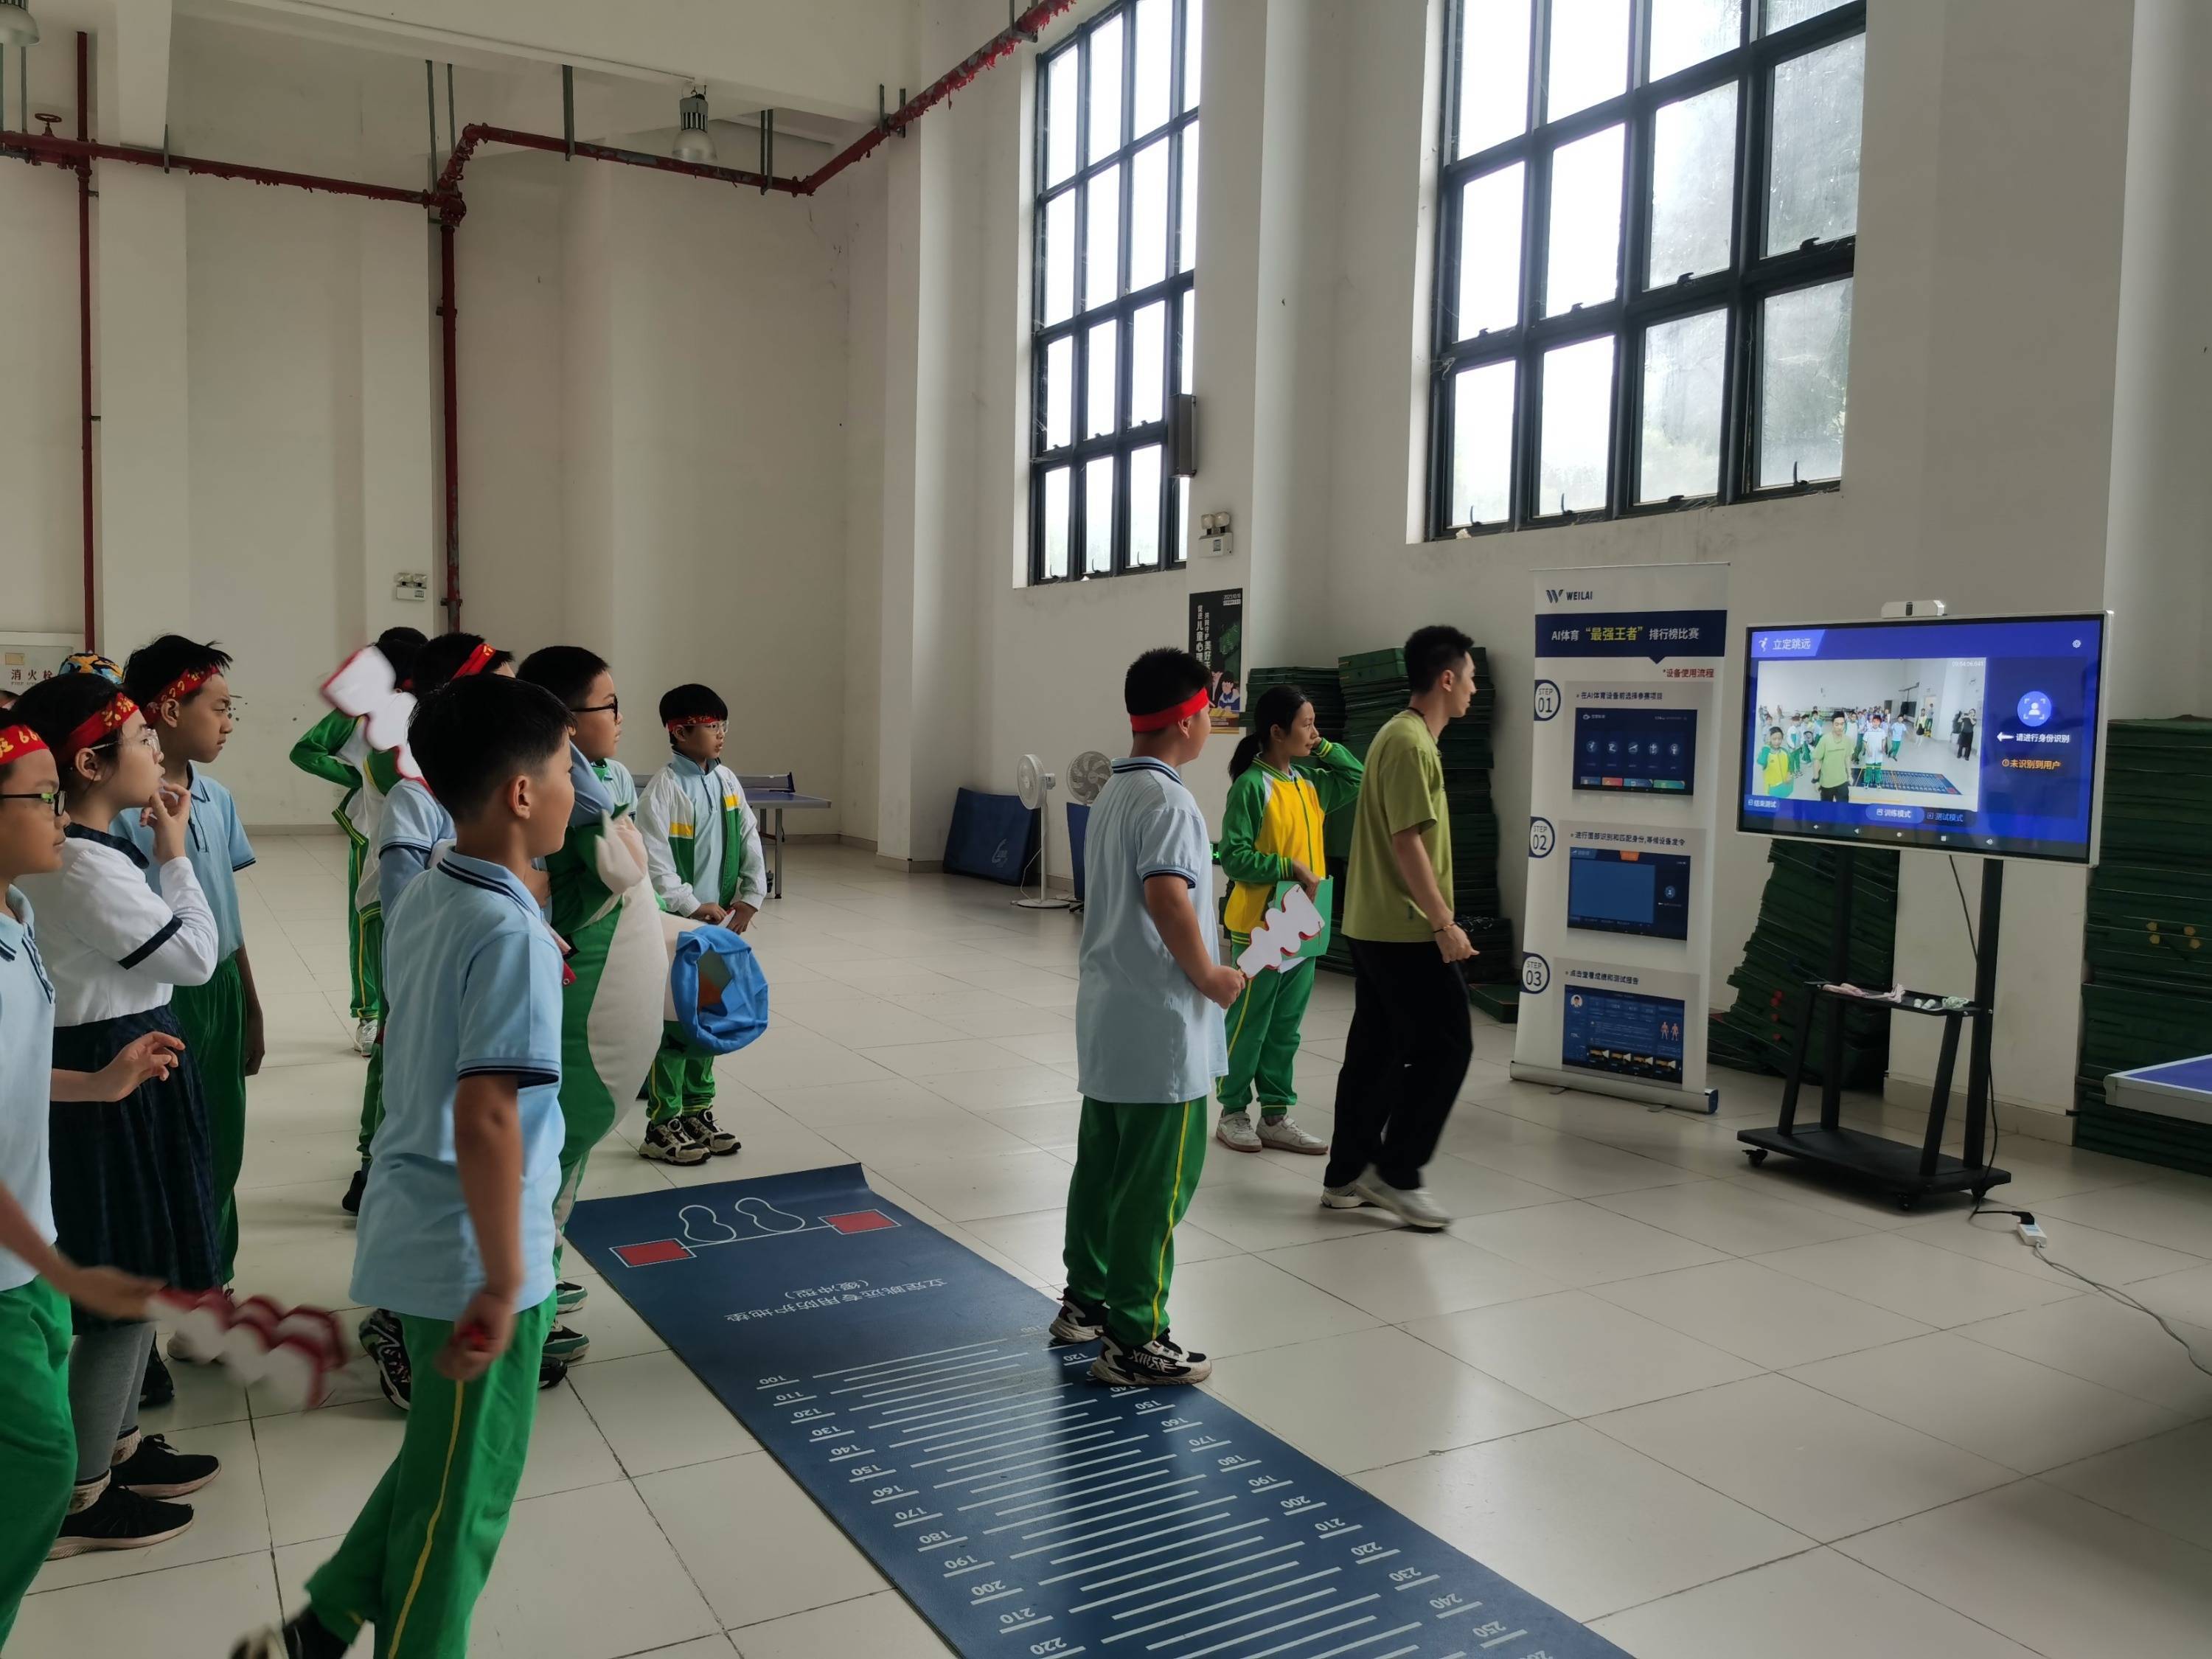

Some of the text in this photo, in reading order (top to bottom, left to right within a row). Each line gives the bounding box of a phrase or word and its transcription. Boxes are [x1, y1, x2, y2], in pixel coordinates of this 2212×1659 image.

[1566, 591, 1593, 601] WEILAI
[1773, 638, 1811, 650] 立定跳远
[11, 668, 53, 681] 消火栓
[1538, 698, 1553, 714] 01
[2016, 733, 2070, 744] 请进行身份识别
[2010, 759, 2062, 771] 未识别到用户
[1884, 810, 1912, 819] 训练模式
[1935, 813, 1964, 823] 测试模式
[1532, 835, 1547, 851] 02
[1526, 961, 1542, 969] STEP
[1526, 972, 1542, 987] 03
[724, 1278, 947, 1322] 立定跳远专用防护地垫
[1062, 1352, 1089, 1362] 120
[759, 1374, 787, 1385] 100
[775, 1391, 804, 1401] 110
[1134, 1399, 1162, 1411] 150
[793, 1408, 823, 1419] 120
[1160, 1417, 1189, 1427] 160
[811, 1425, 841, 1437] 130
[1188, 1435, 1217, 1447] 170
[830, 1444, 861, 1456] 140
[1217, 1454, 1247, 1466] 180
[850, 1464, 883, 1477] 150
[1248, 1475, 1279, 1487] 190
[872, 1484, 904, 1498] 160
[1280, 1495, 1312, 1509] 200
[894, 1506, 928, 1520] 170
[1314, 1517, 1346, 1531] 210
[919, 1530, 953, 1544] 180
[1350, 1541, 1383, 1557] 220
[944, 1554, 978, 1570] 190
[1388, 1566, 1422, 1582] 230
[970, 1579, 1006, 1596] 200
[1429, 1593, 1463, 1610] 240
[999, 1607, 1036, 1624] 210
[1472, 1620, 1507, 1638] 250
[1029, 1636, 1068, 1655] 220
